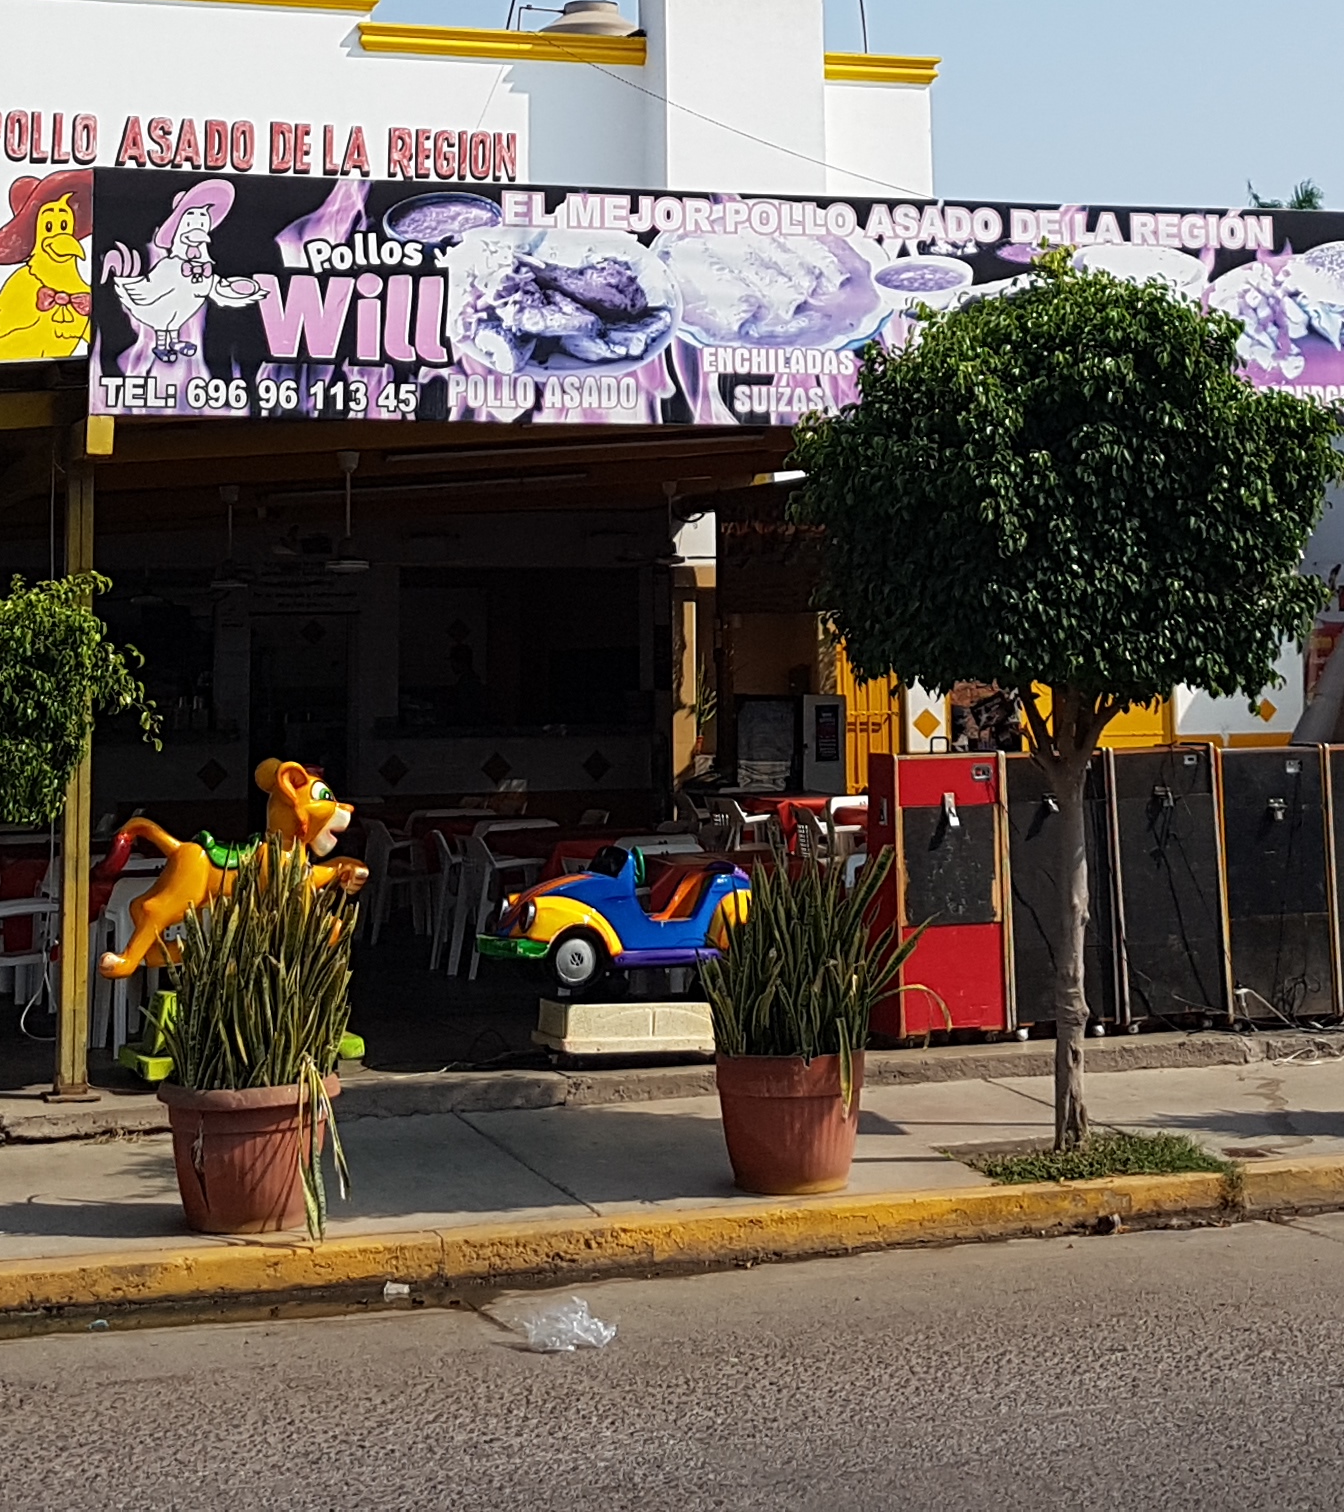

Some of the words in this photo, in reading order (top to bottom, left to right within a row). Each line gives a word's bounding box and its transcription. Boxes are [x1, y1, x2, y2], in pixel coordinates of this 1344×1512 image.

[115, 115, 254, 171] ASADO
[269, 121, 312, 175] DE
[323, 124, 370, 178] LA
[388, 127, 517, 181] REGION
[501, 190, 554, 229] EL
[567, 192, 715, 234] MEJOR
[725, 199, 856, 238] POLLO
[865, 203, 1003, 242] ASADO
[1010, 208, 1061, 244] DE
[1074, 211, 1125, 246] LA
[1130, 208, 1274, 250] REGIÓN
[307, 232, 423, 273] Pollos
[257, 272, 449, 363] Will
[703, 347, 855, 374] ENCHILADAS
[100, 377, 176, 407] TEL:
[187, 378, 248, 409] 696
[259, 379, 299, 410] 96
[310, 381, 368, 412] 113
[378, 383, 418, 412] 45
[448, 374, 534, 409] POLLO
[544, 376, 638, 410] ASADO
[733, 385, 825, 413] SUIZAS
